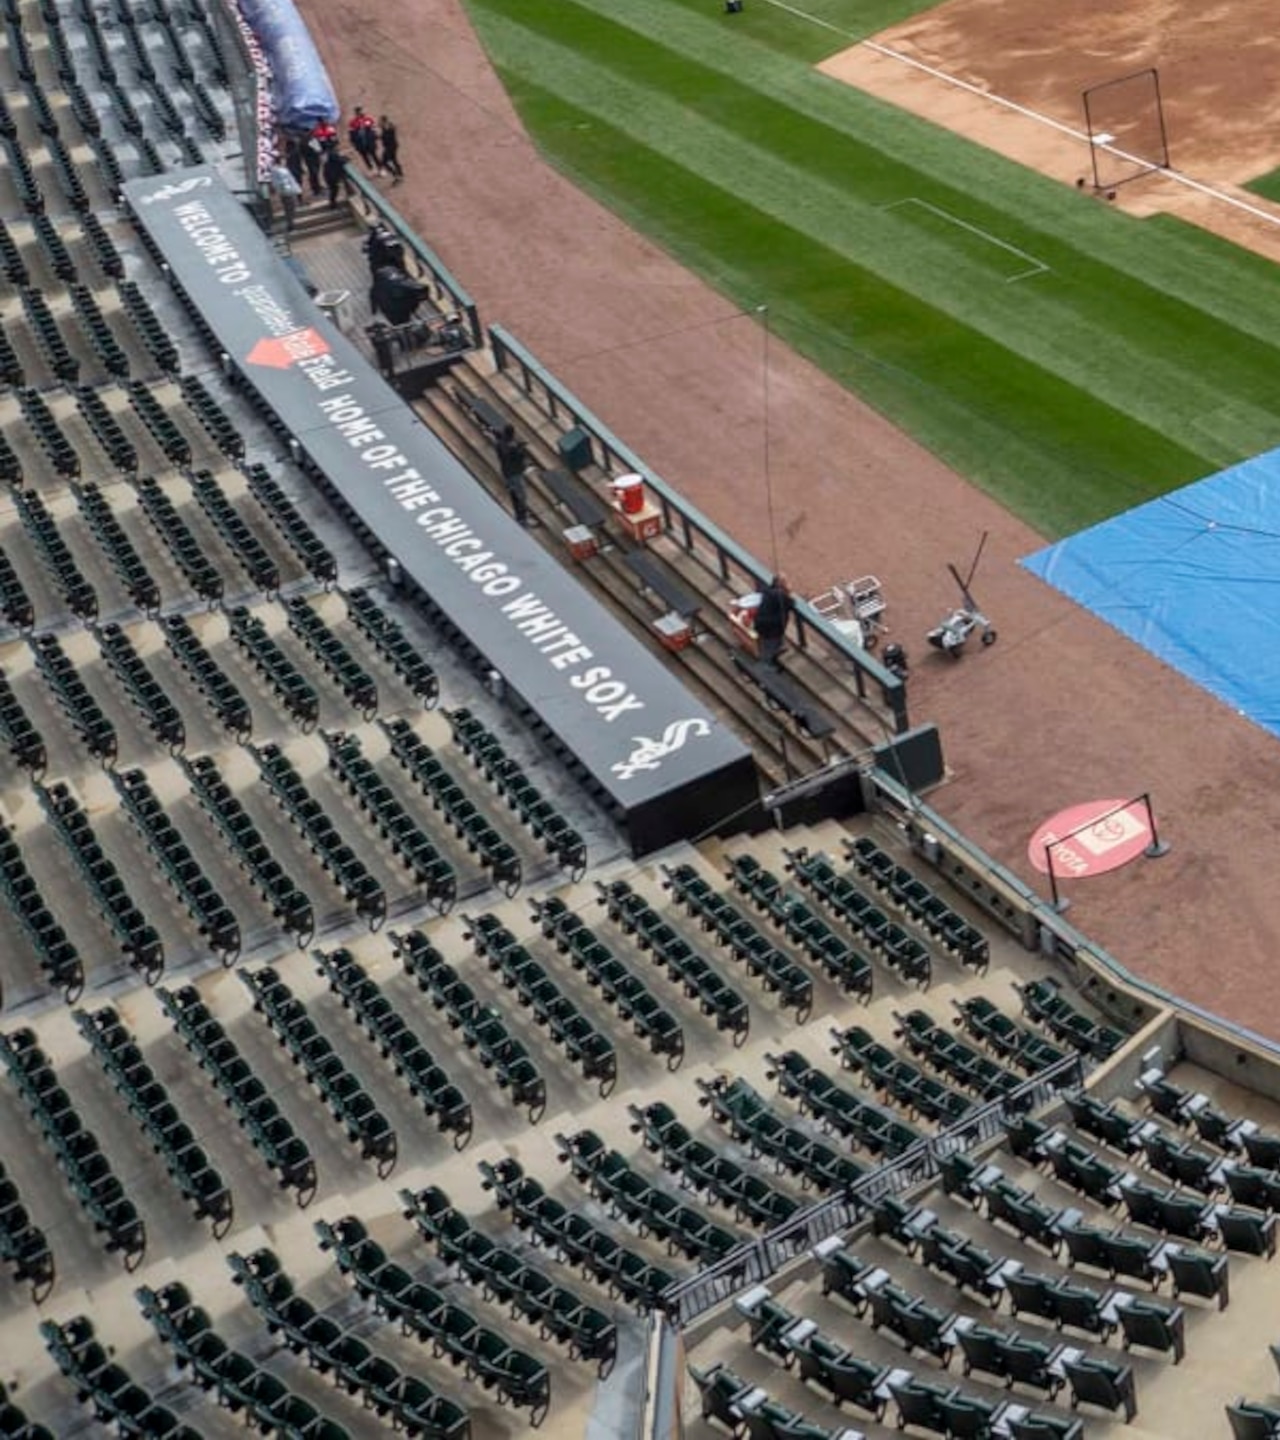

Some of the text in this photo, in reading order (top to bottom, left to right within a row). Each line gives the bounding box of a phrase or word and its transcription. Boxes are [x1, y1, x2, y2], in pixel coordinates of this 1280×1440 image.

[170, 199, 252, 285] WELCOME TO
[317, 393, 646, 722] HOME OF THE CHICAGO WHITE SOX
